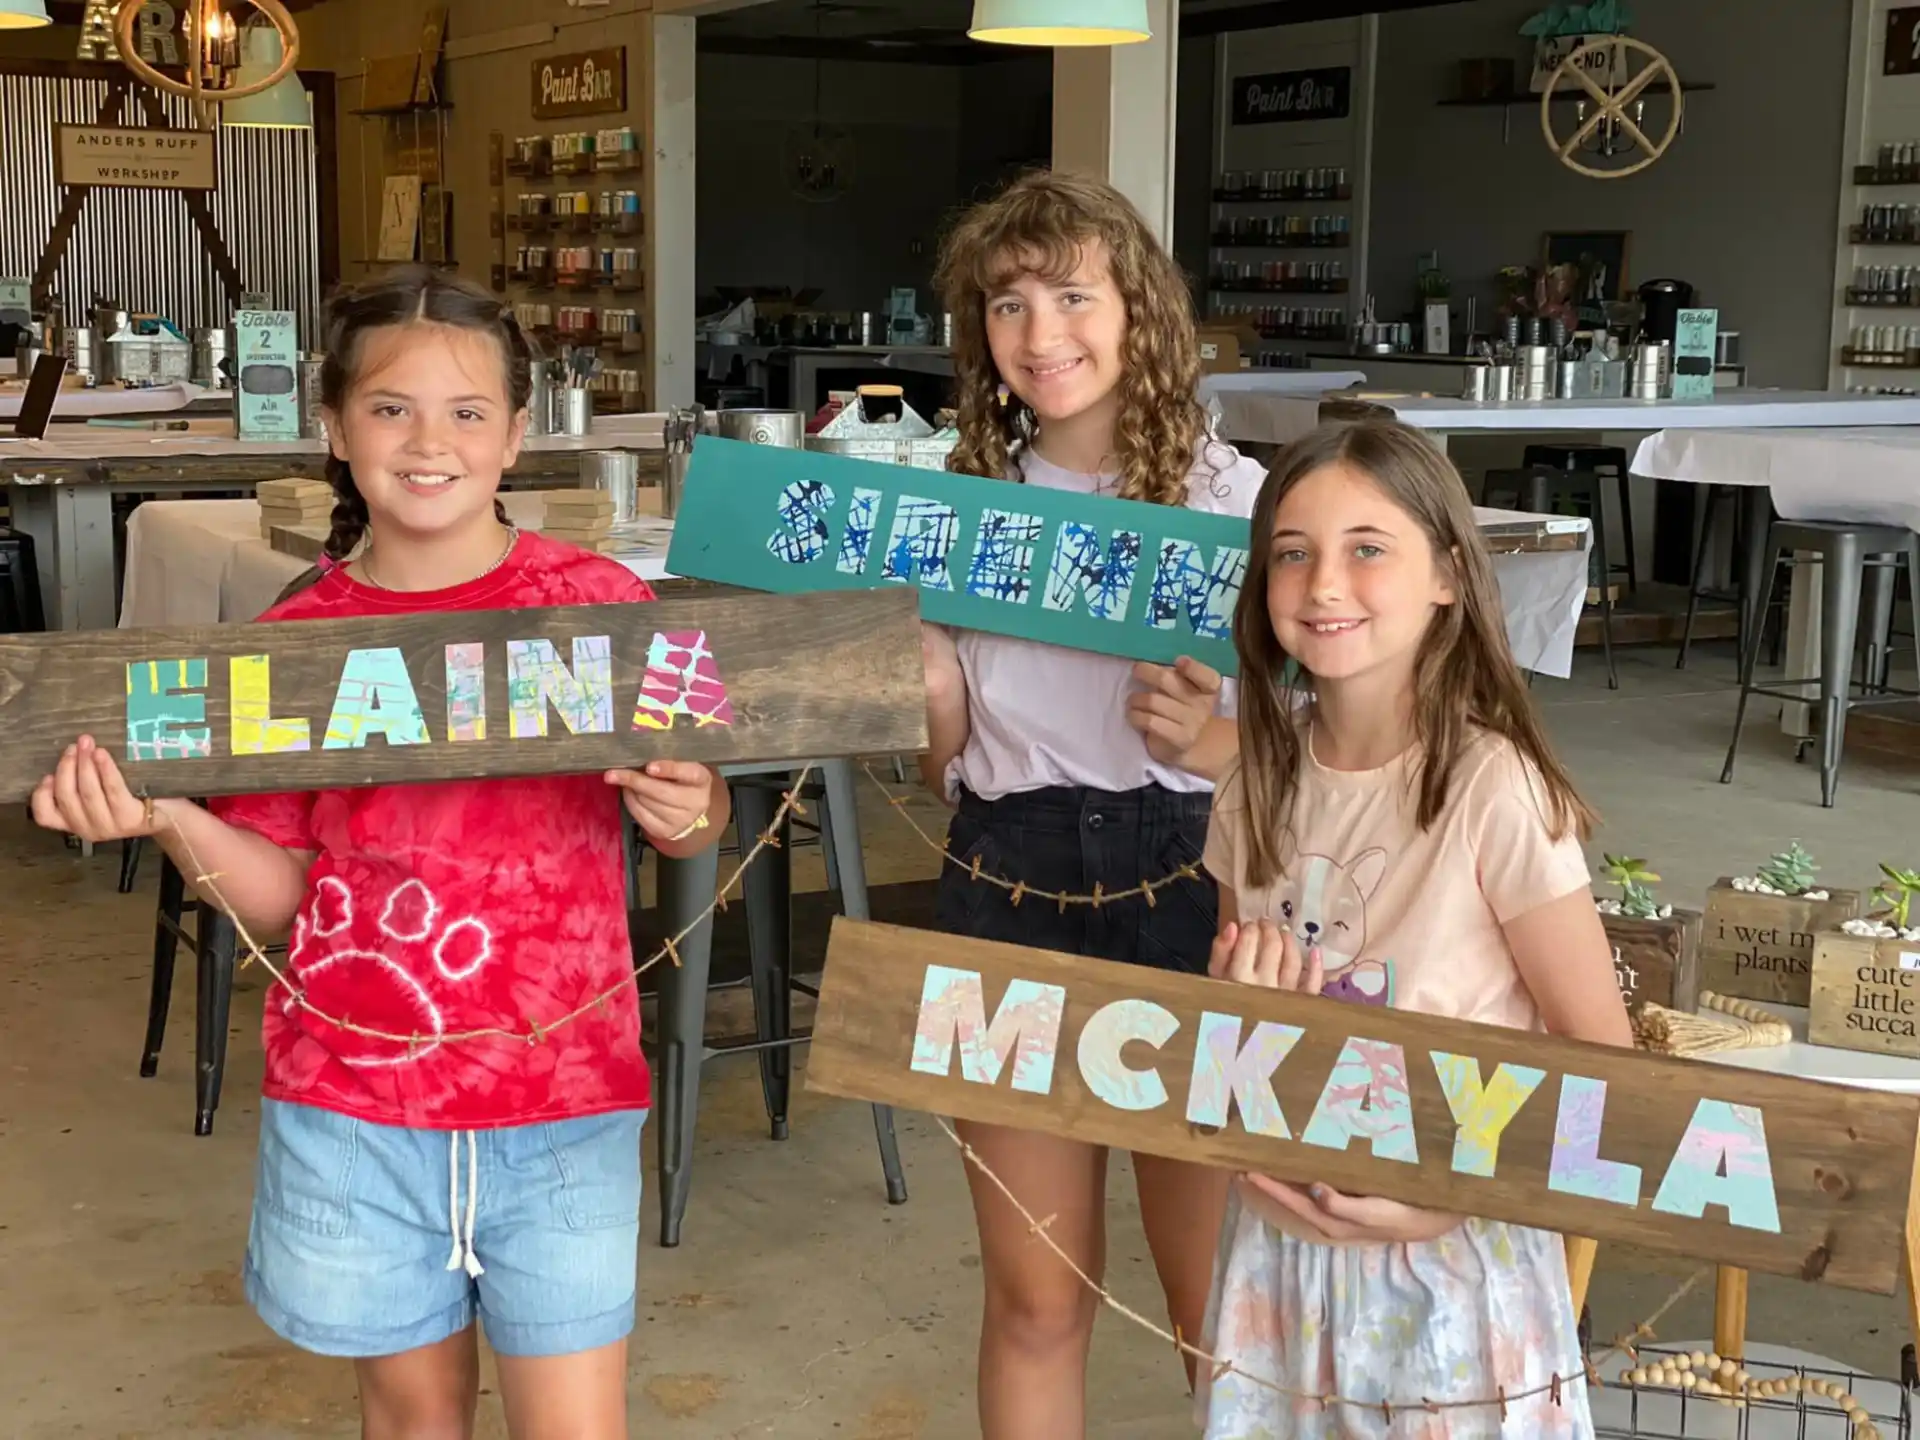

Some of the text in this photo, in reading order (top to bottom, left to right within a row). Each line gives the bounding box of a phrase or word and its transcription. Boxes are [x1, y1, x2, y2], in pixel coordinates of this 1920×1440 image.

[541, 65, 579, 105] Paint
[1247, 84, 1294, 114] Paint
[76, 134, 198, 149] ANDERS RUFF
[242, 311, 291, 327] Table
[260, 330, 271, 348] 2
[126, 630, 734, 761] ELAINA
[1717, 918, 1815, 949] i wet m
[1735, 946, 1809, 976] plants
[1857, 966, 1914, 988] cute
[1852, 984, 1915, 1015] little
[1846, 1012, 1916, 1037] succa
[910, 963, 1782, 1234] MCKAYLA
